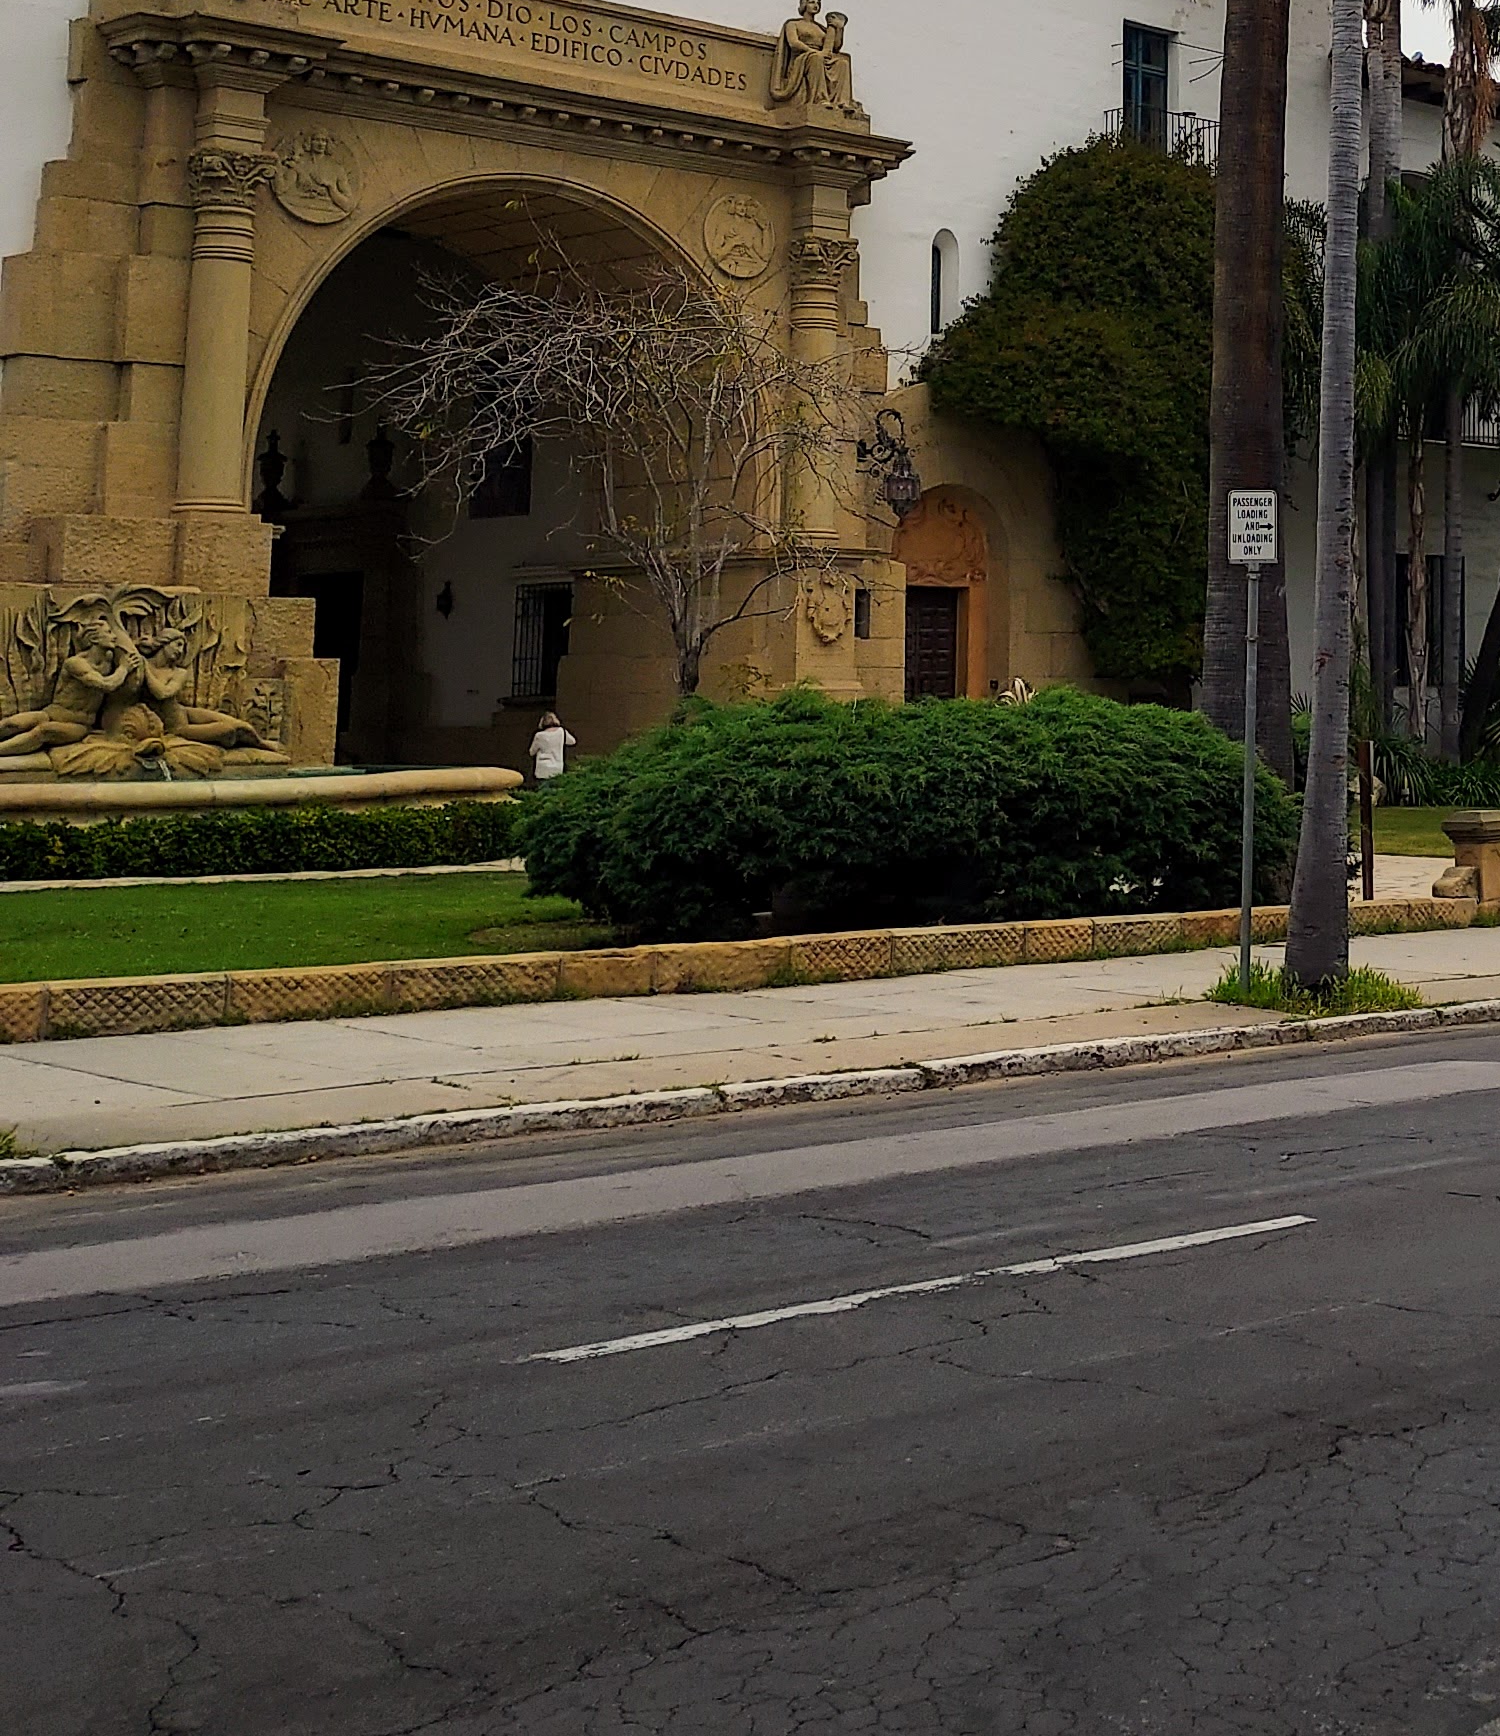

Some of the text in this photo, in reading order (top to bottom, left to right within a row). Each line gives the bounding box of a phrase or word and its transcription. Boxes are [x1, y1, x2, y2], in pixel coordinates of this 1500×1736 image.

[549, 12, 592, 37] LOS
[609, 25, 707, 61] CAMPOS
[410, 7, 516, 47] HVMANA
[531, 32, 623, 67] EDIFICO
[639, 54, 748, 91] CIVDADES
[1232, 497, 1273, 507] PASSENGER
[1237, 509, 1268, 519] LOADING
[1245, 521, 1260, 531] AND
[1232, 533, 1273, 543] UNLOADING
[1243, 545, 1262, 556] ONLY
